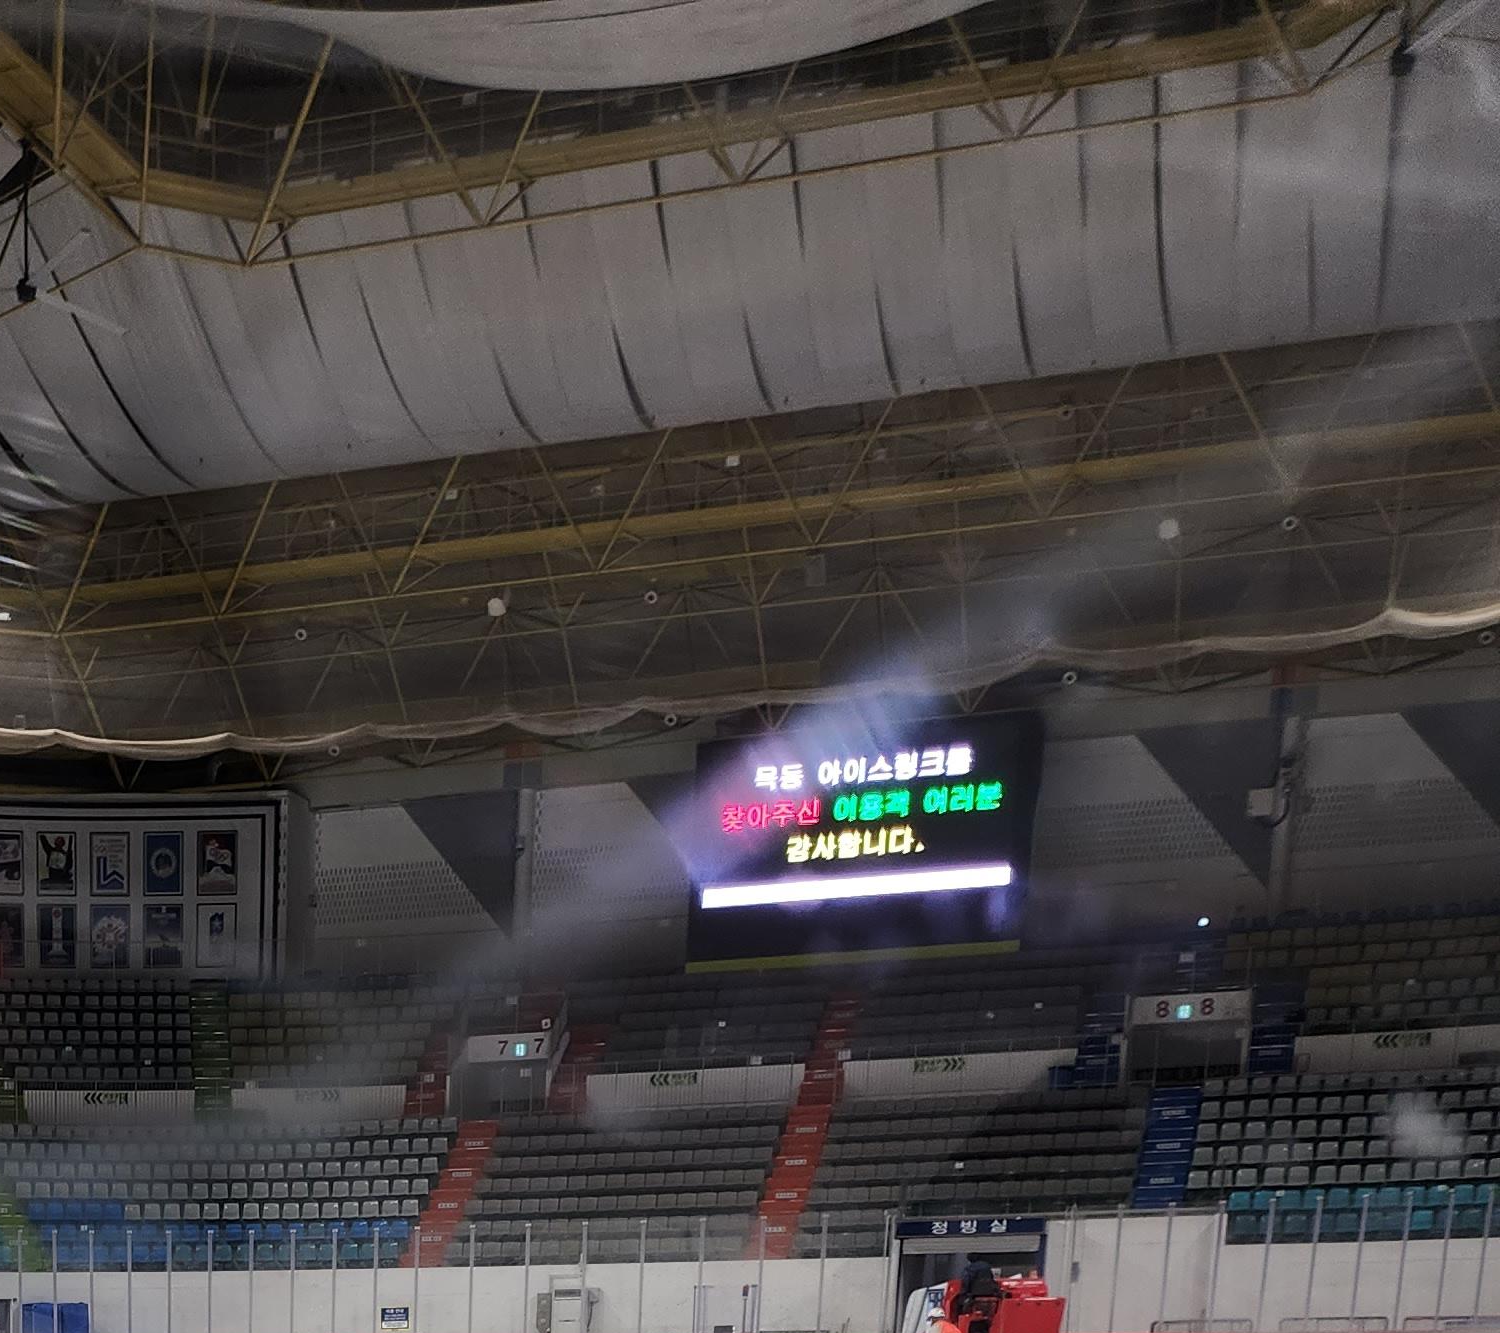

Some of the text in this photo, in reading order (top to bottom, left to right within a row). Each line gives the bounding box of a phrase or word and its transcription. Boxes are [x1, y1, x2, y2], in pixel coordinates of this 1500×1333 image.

[755, 763, 804, 790] 목동
[722, 781, 1003, 833] 찾아주신 이용객 여러분
[786, 825, 925, 863] 감사합니다.
[1156, 998, 1214, 1018] 8 8
[498, 1038, 544, 1055] 7 7
